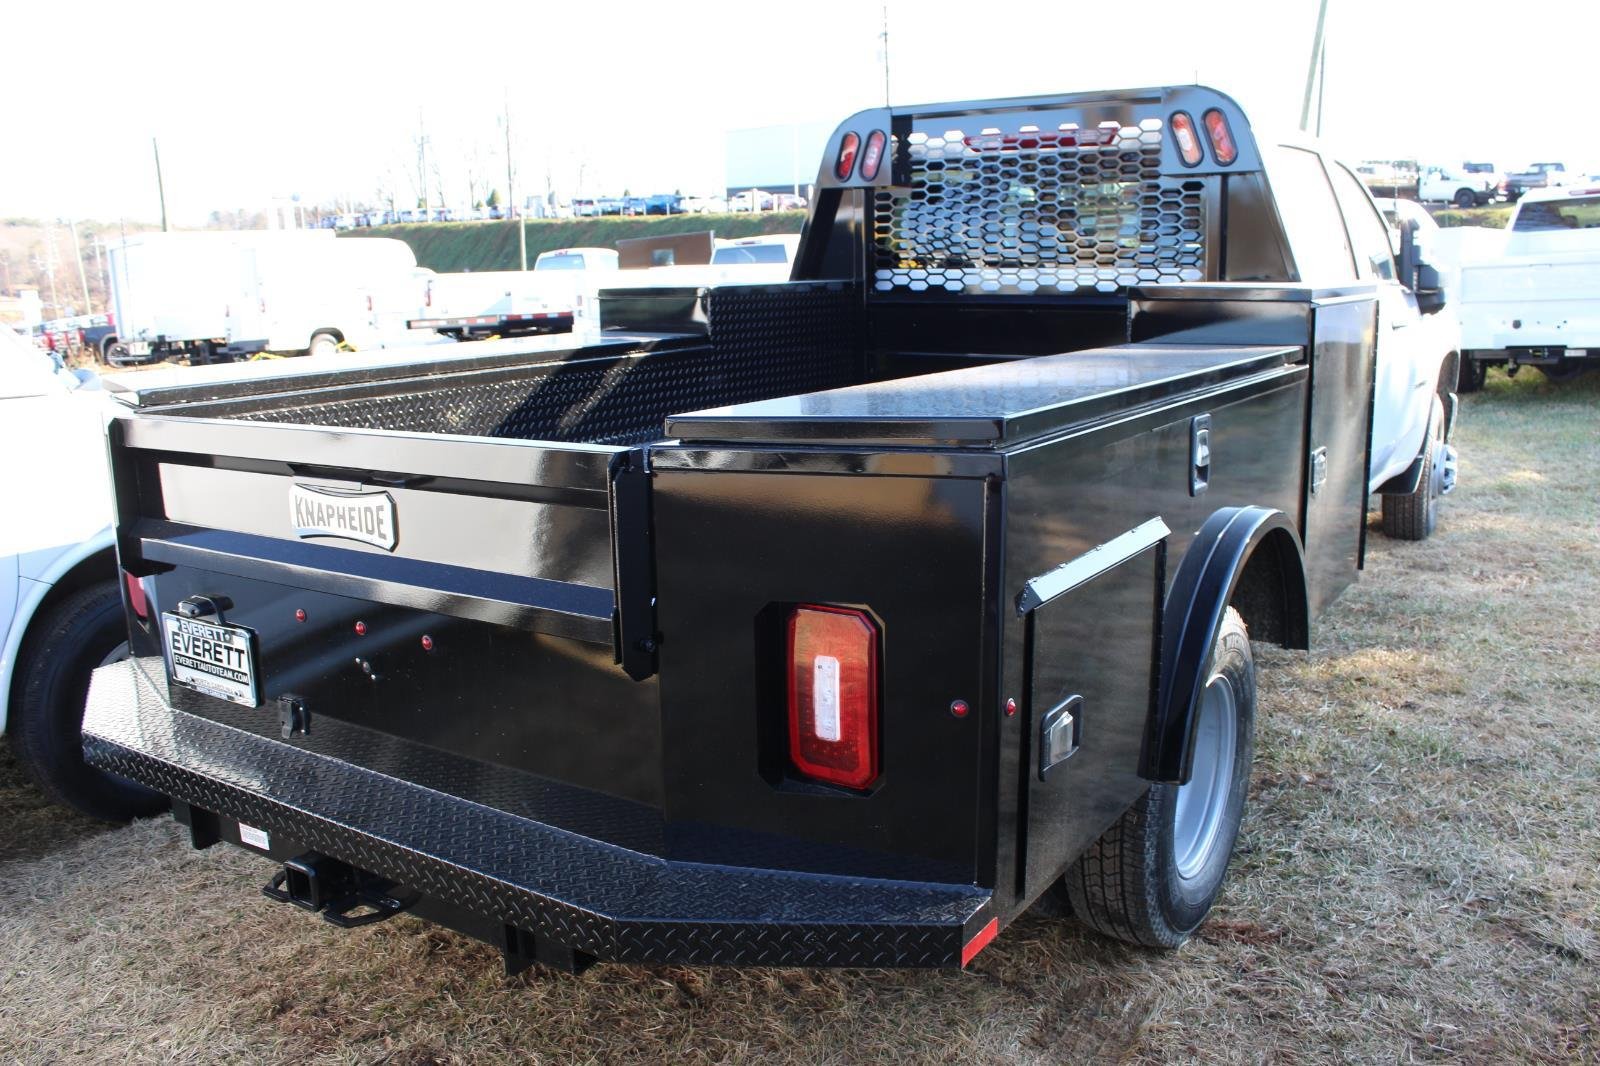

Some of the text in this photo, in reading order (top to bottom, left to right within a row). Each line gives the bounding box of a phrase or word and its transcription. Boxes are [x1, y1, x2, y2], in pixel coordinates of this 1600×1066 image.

[295, 496, 387, 540] KNAPHEIDE
[180, 620, 225, 642] EVERETT
[171, 631, 245, 669] EVERETT
[175, 655, 249, 684] EVERETTAUTOTEAM.COM
